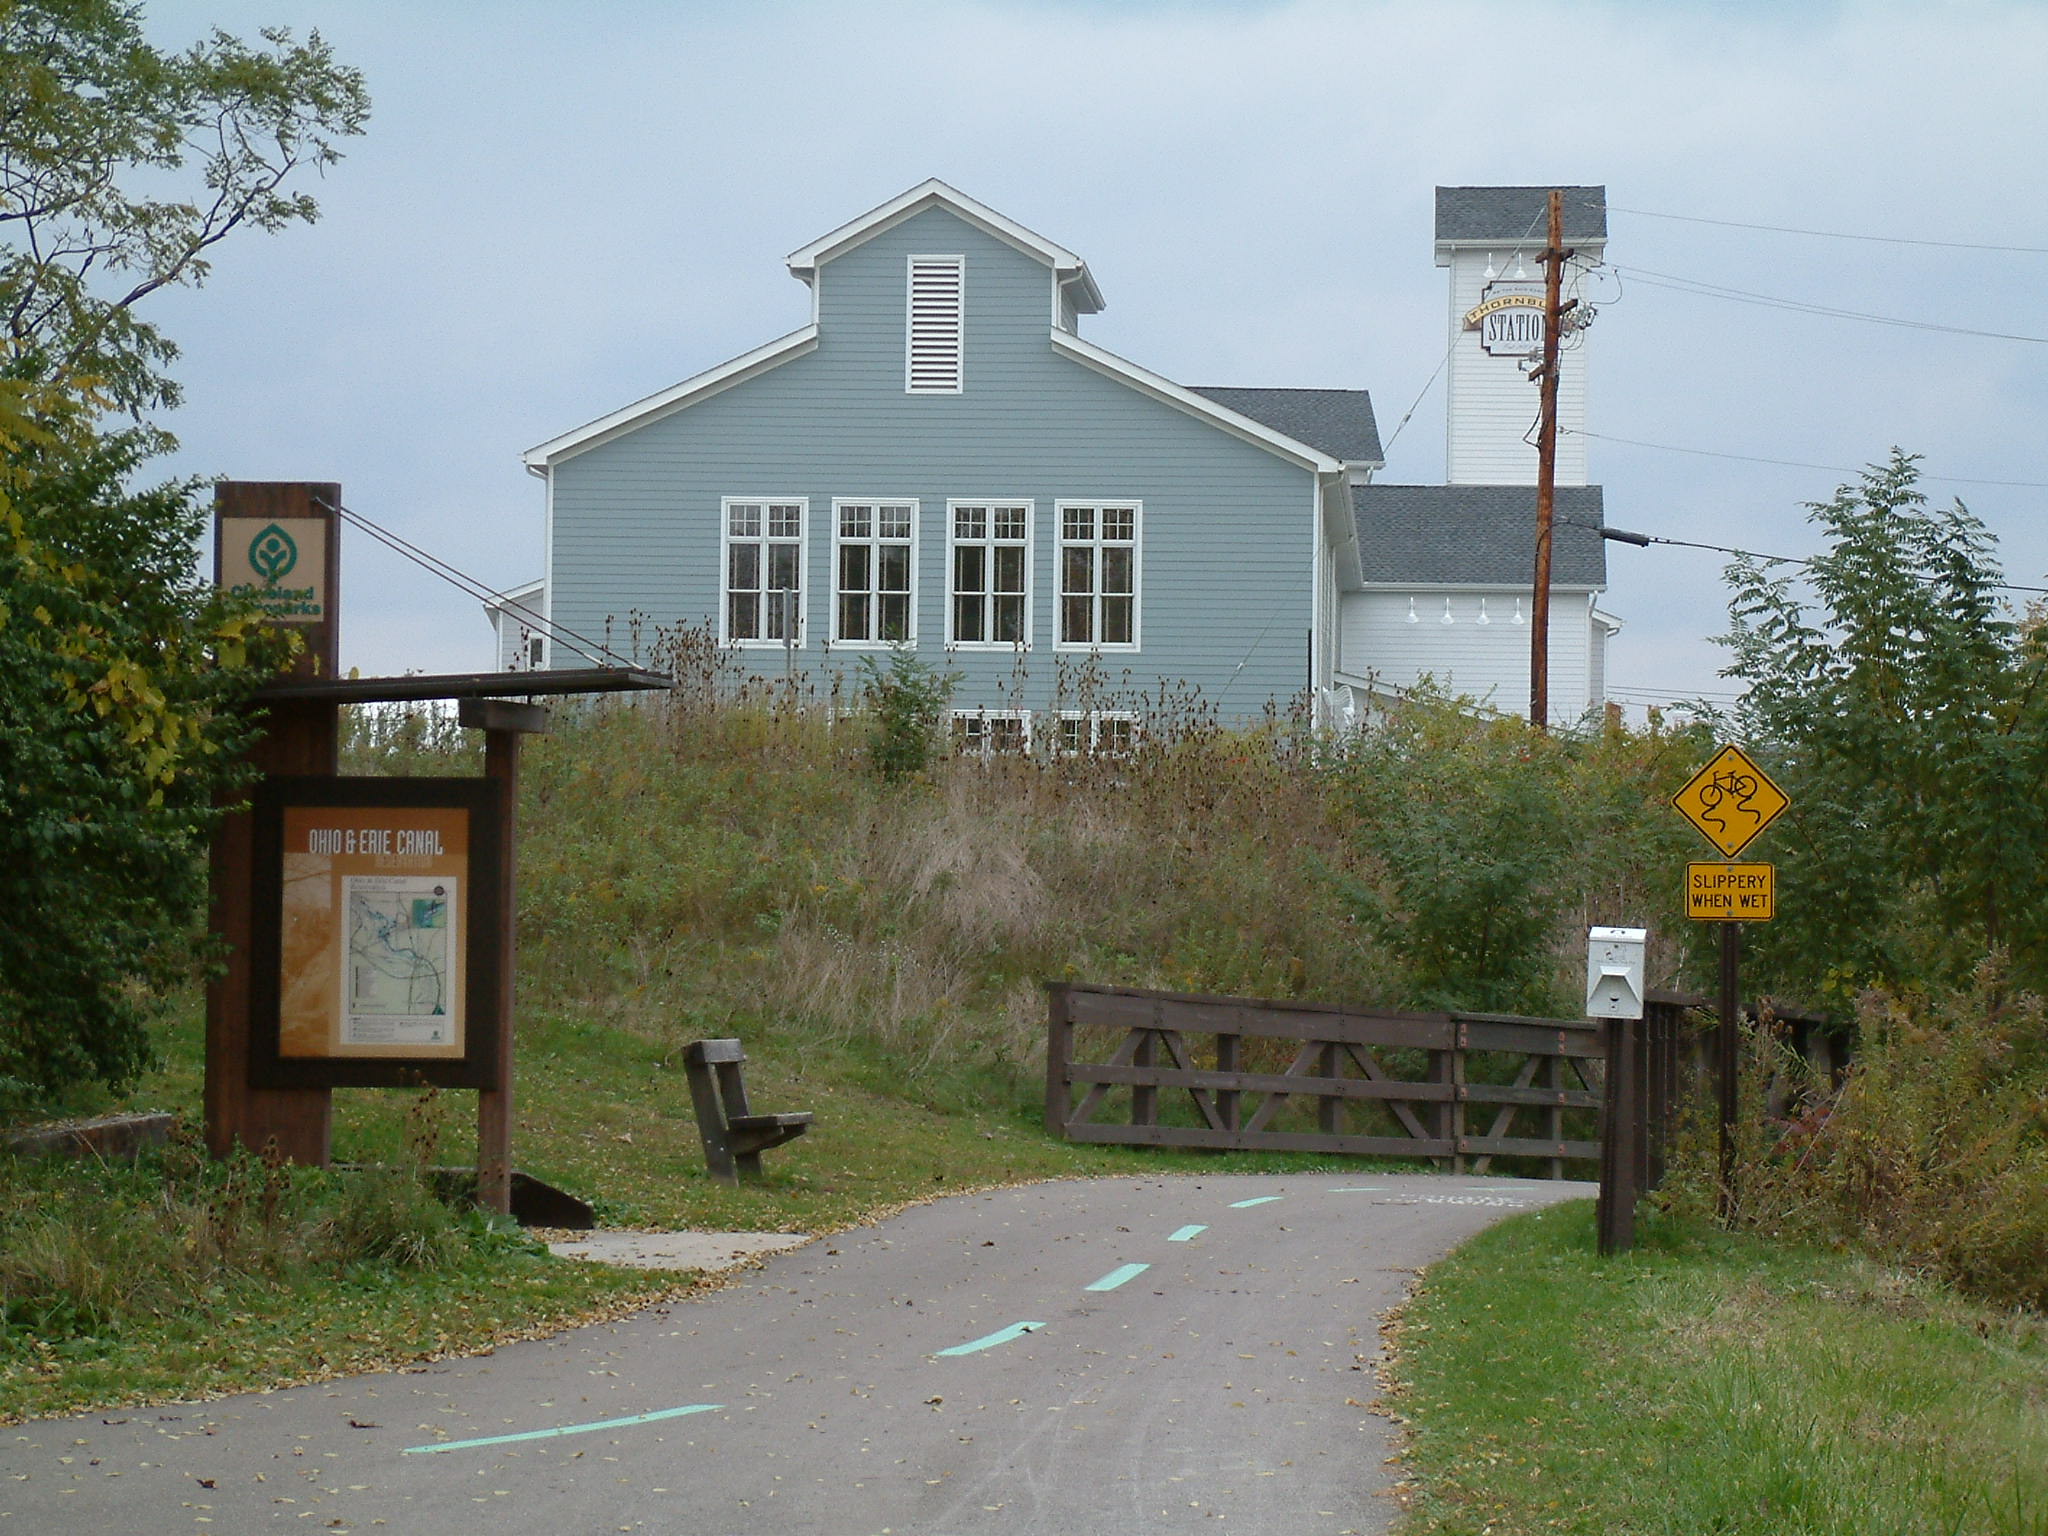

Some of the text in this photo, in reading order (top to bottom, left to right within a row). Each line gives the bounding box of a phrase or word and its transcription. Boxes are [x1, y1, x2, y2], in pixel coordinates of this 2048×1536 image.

[309, 828, 445, 856] OHIO & ERIE CANAL
[1693, 874, 1766, 889] SLIPPERY
[1692, 893, 1768, 908] WHEN WET
